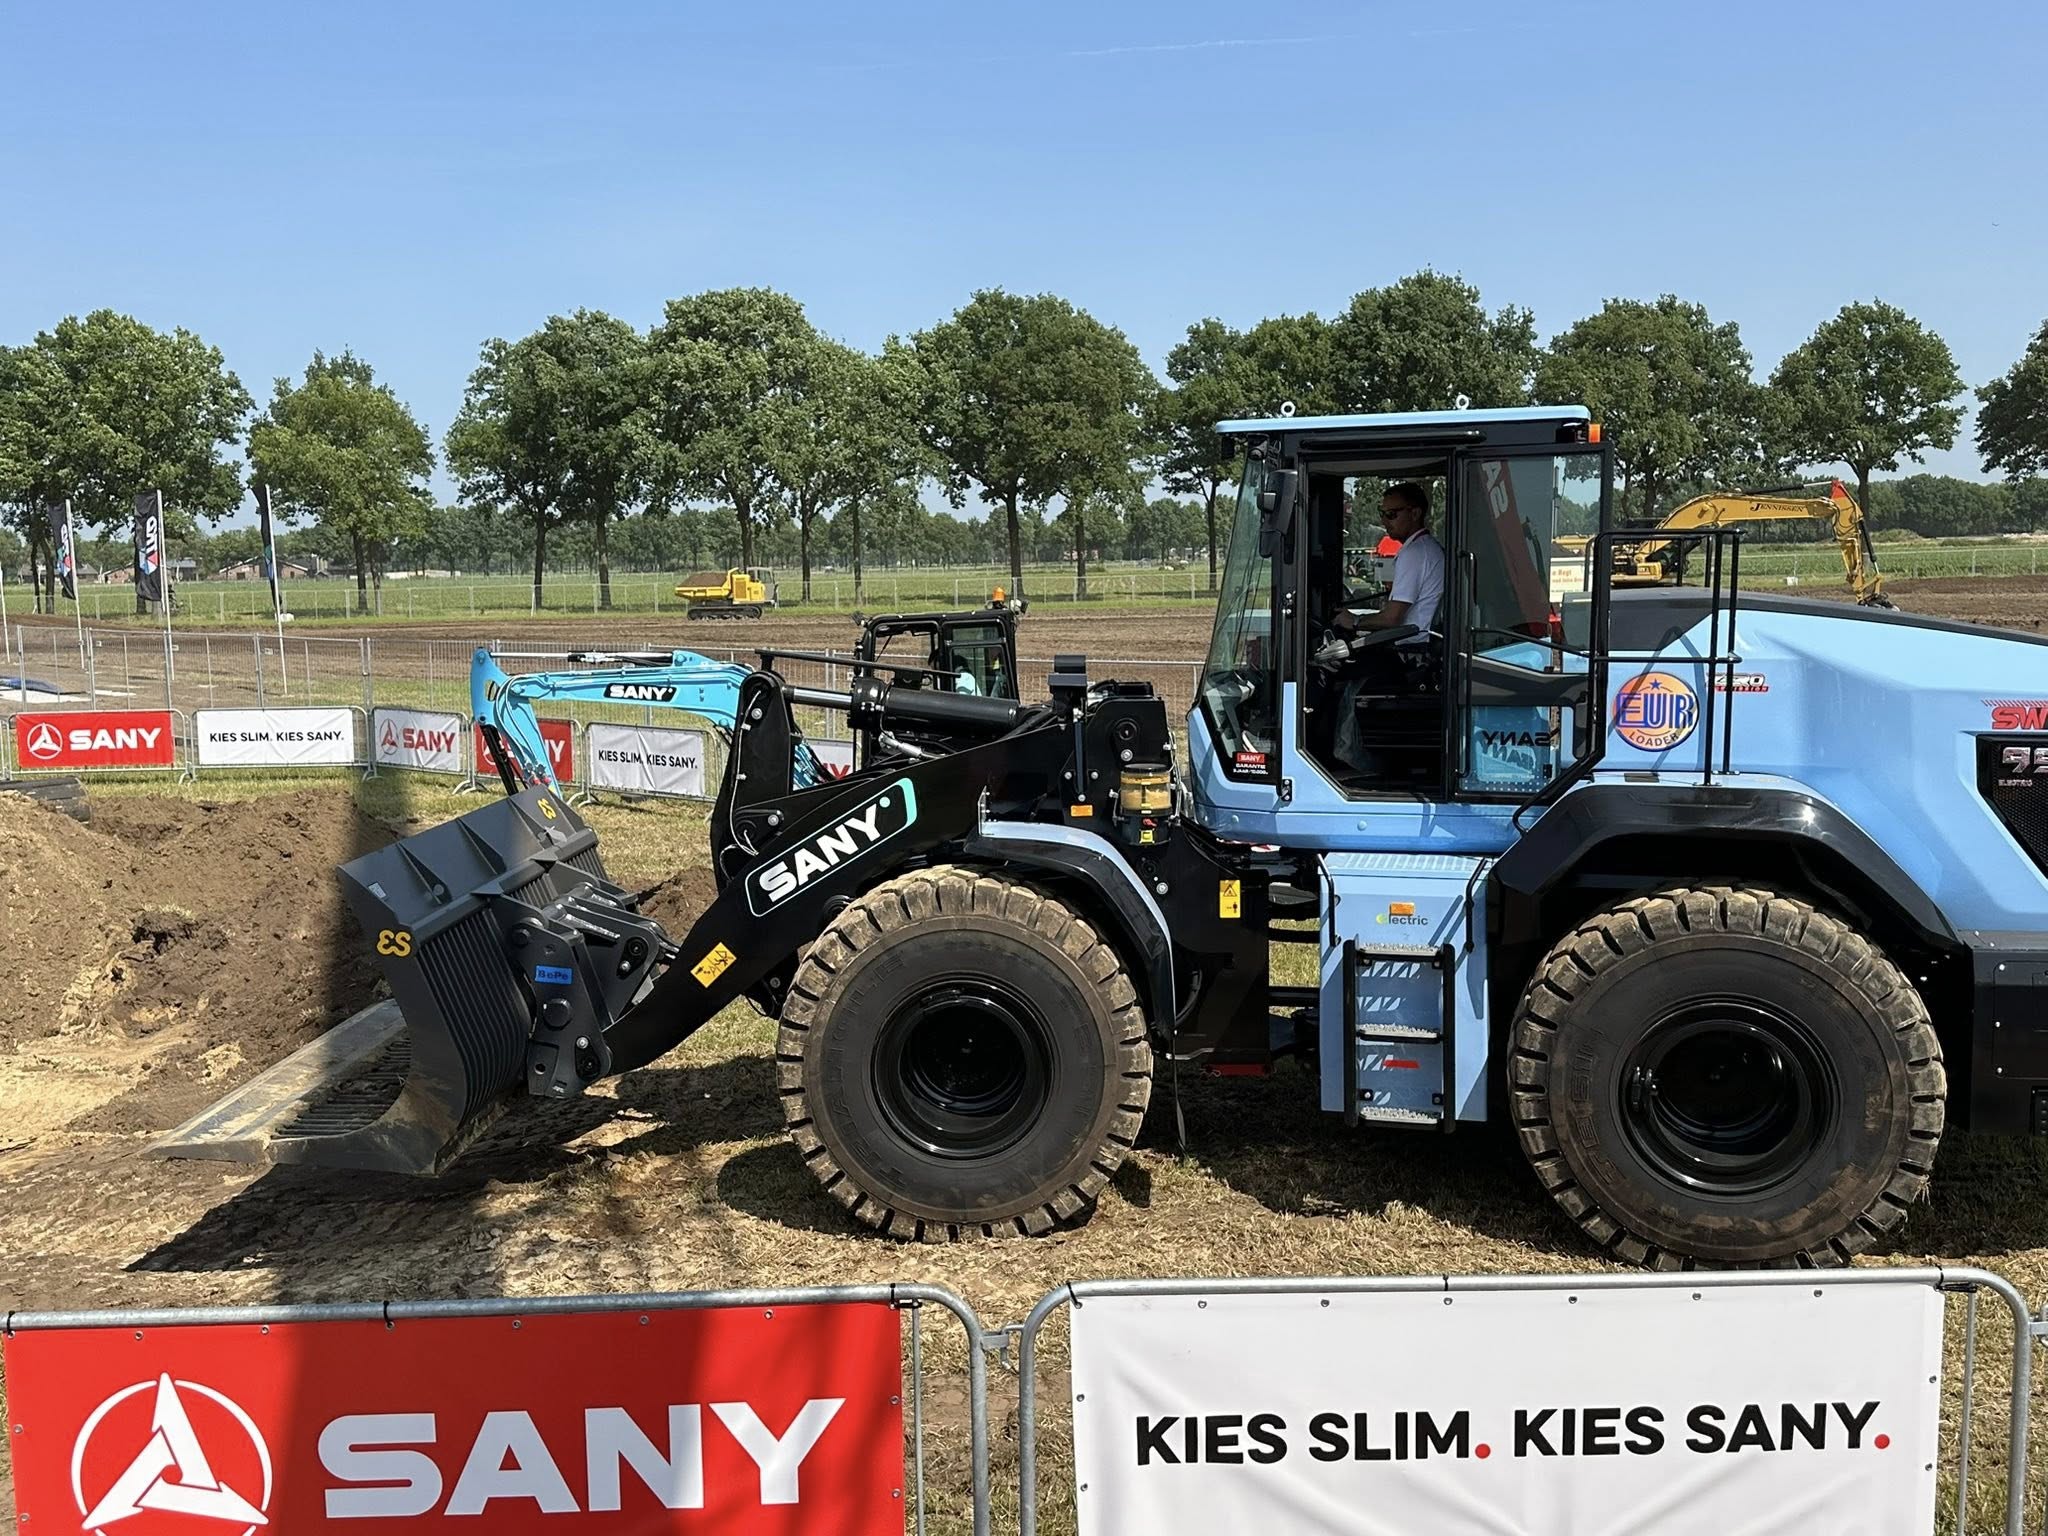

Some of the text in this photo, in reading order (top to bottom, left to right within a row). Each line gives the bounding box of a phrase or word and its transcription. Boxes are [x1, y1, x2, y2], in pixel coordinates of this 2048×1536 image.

[1750, 503, 1803, 513] JENNISSEN
[609, 685, 667, 700] SANY
[69, 728, 161, 750] SANY
[209, 731, 345, 742] KIES SLIM. KIES SANY.
[402, 727, 456, 753] SANY
[1629, 731, 1679, 747] LOADER
[598, 750, 698, 769] KIES SLIM. KIES SANY.
[1240, 754, 1261, 762] SANY
[759, 803, 881, 903] SANY
[1135, 1400, 1892, 1466] KIES SLIM. KIES SANY.
[318, 1397, 847, 1518] SANY
